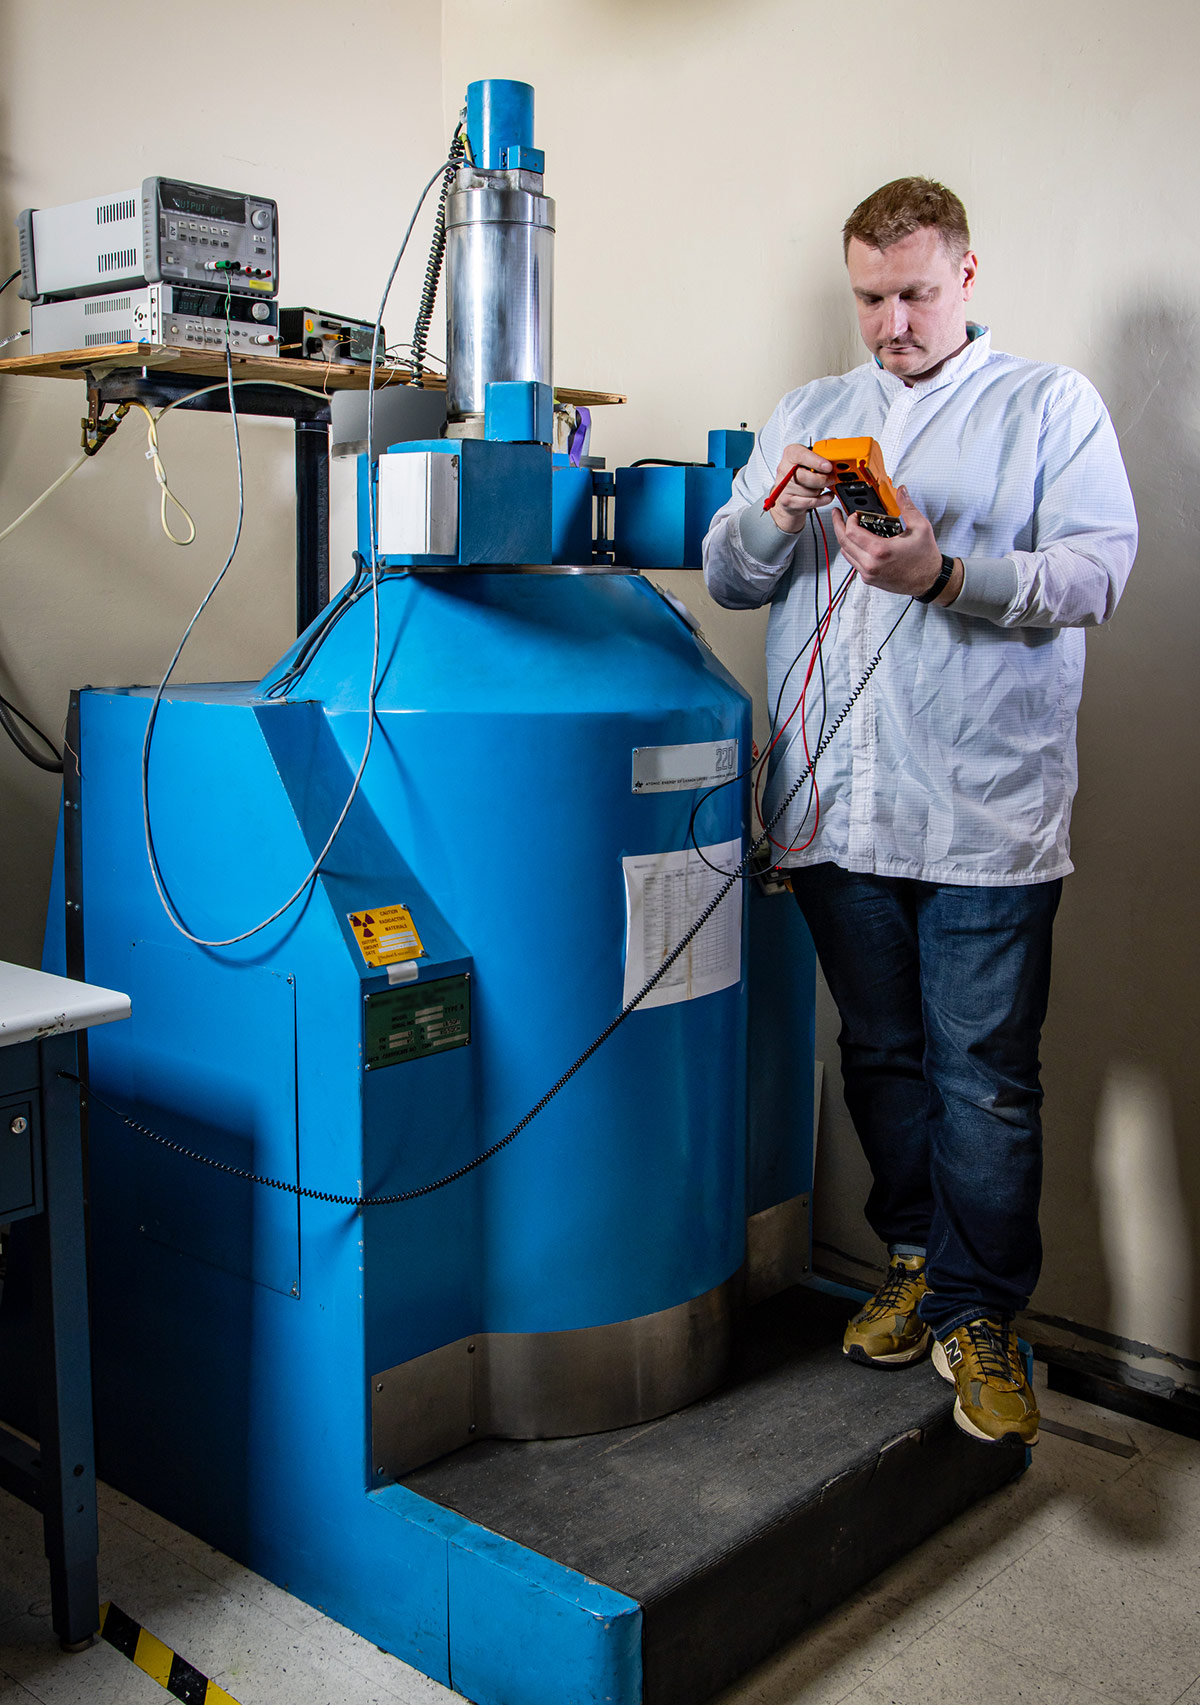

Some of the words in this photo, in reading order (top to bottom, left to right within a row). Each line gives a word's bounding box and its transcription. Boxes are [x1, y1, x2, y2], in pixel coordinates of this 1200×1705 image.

[176, 199, 205, 212] OUTPUT
[210, 205, 225, 214] OFF
[716, 746, 734, 772] 220
[379, 909, 399, 917] CAUTION
[379, 916, 406, 924] RADIOACTIVE
[385, 923, 408, 931] MATERIALS
[363, 943, 379, 951] AMOUNT
[944, 1336, 963, 1368] N
